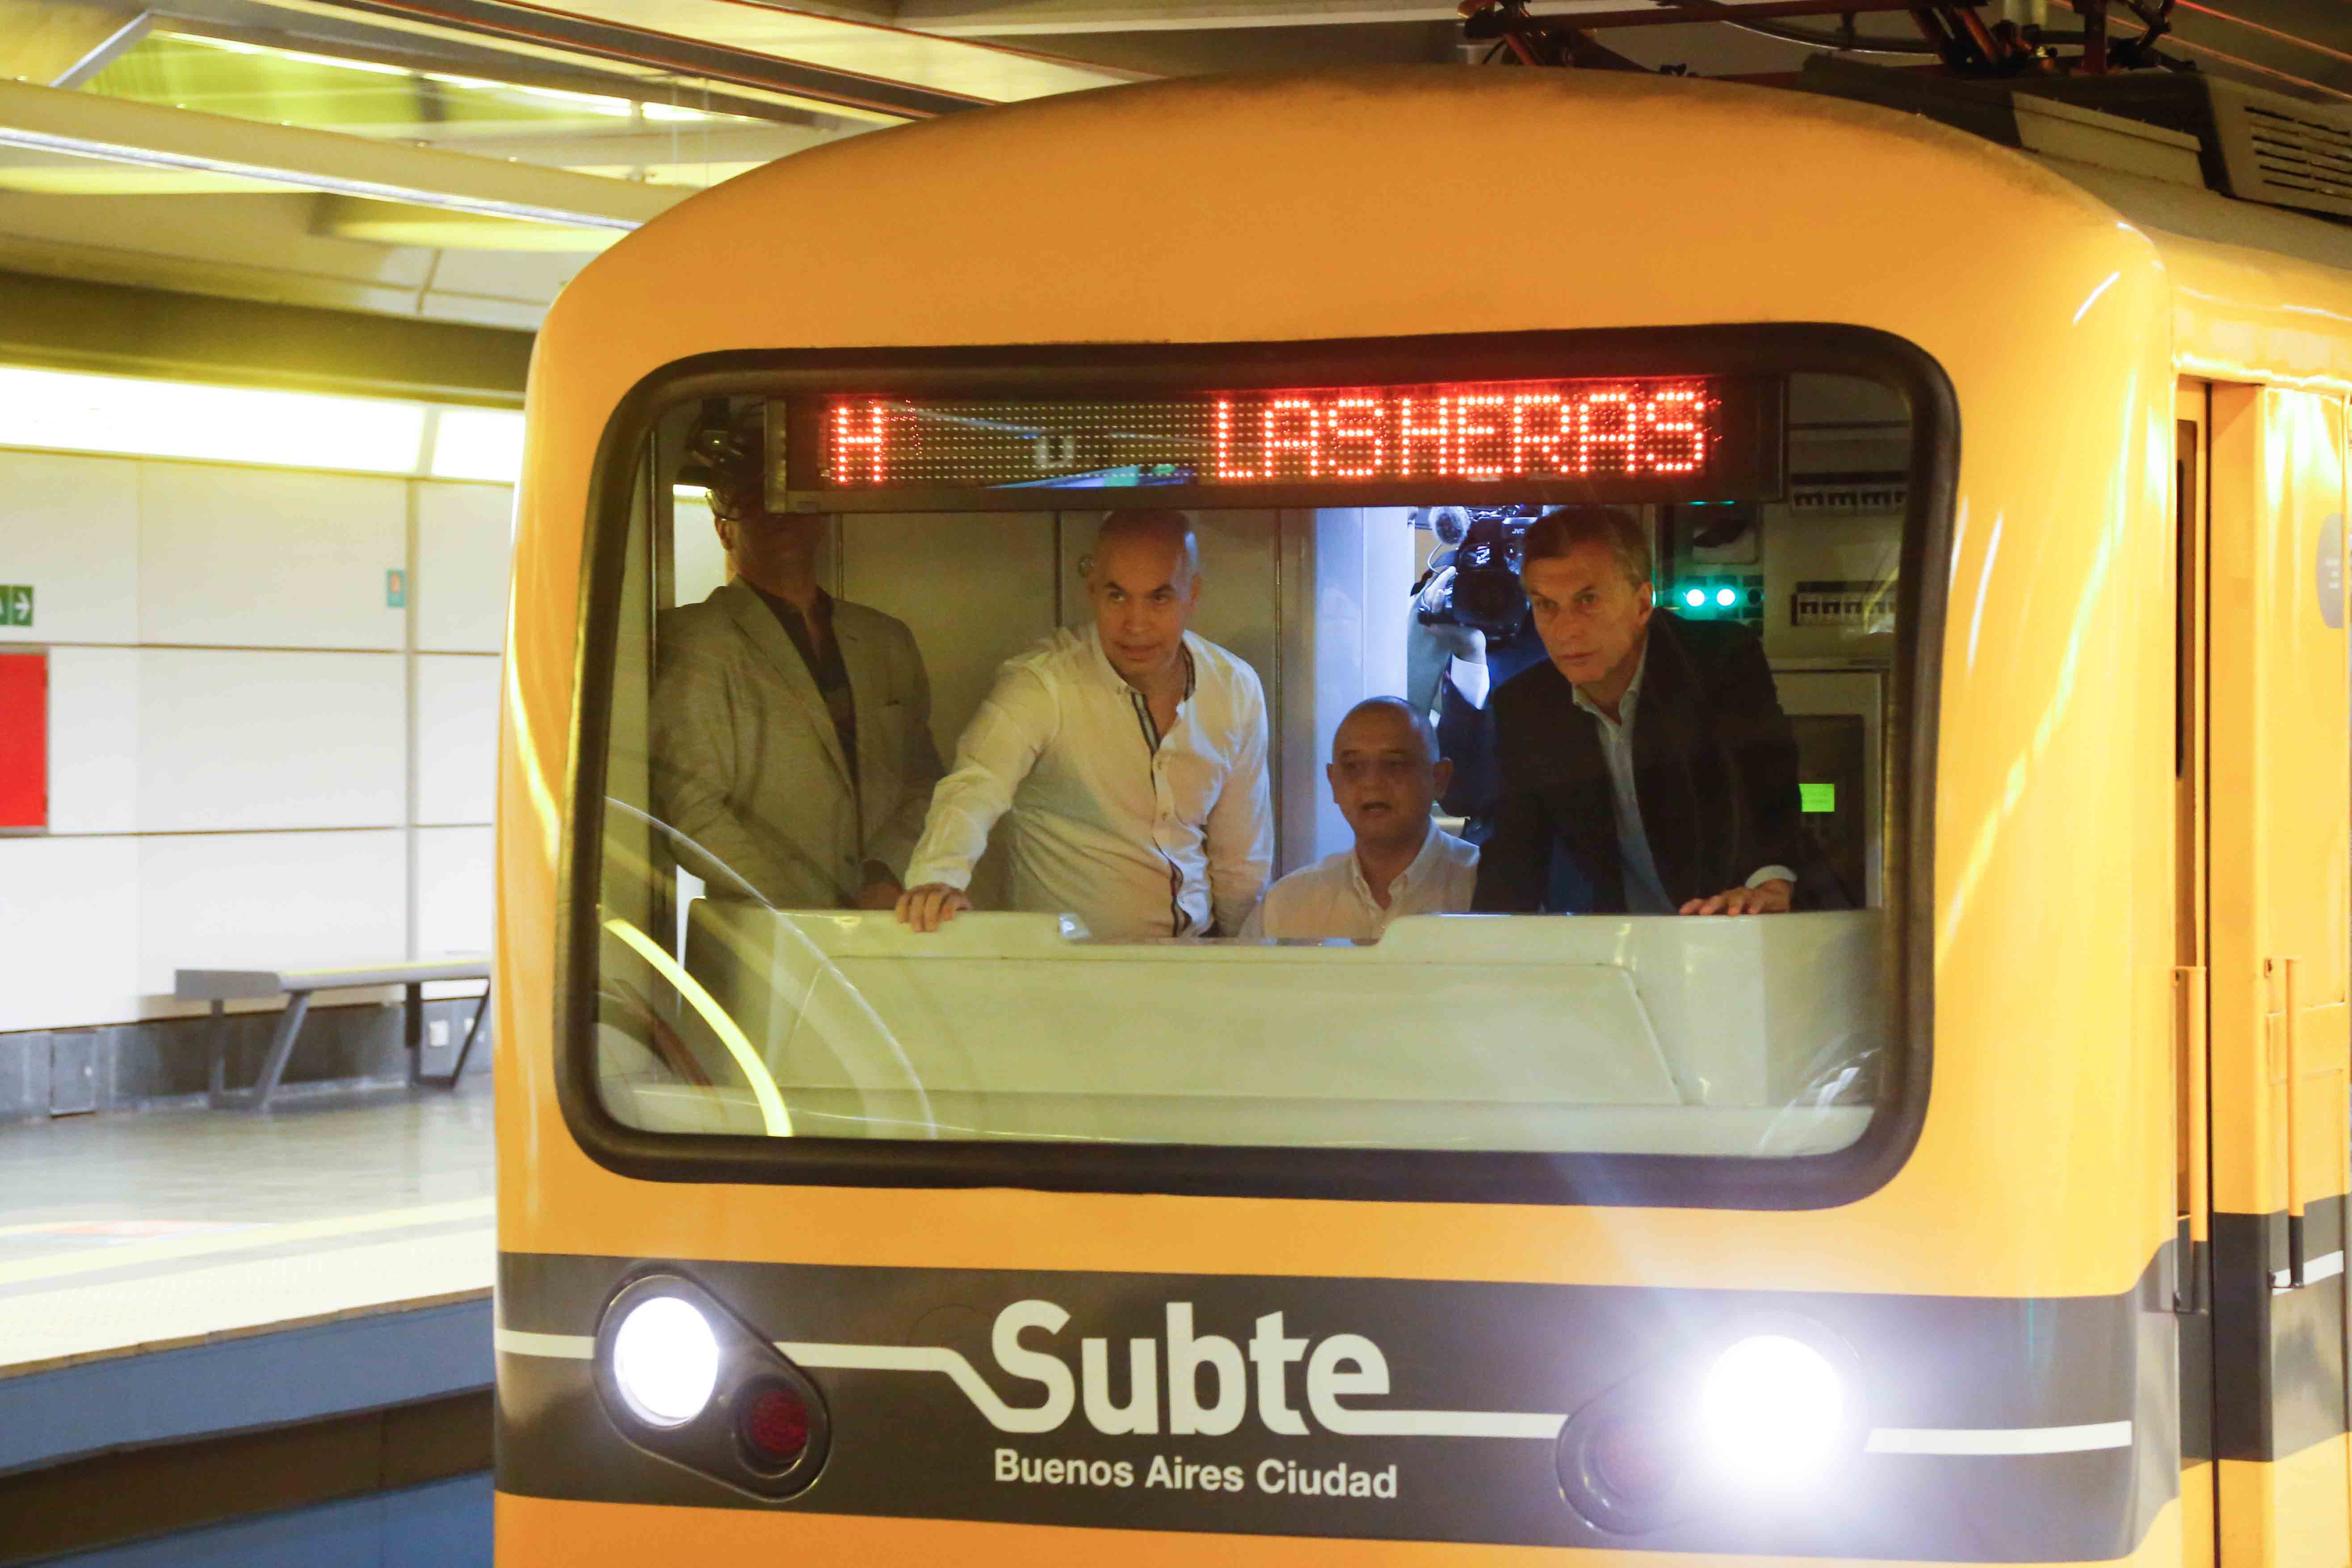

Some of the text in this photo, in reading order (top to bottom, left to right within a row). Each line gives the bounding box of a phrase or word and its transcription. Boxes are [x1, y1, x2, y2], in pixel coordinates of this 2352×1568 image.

[836, 406, 883, 483] H
[991, 1299, 1390, 1436] Subte
[994, 1448, 1398, 1498] Buenos Aires Ciudad
